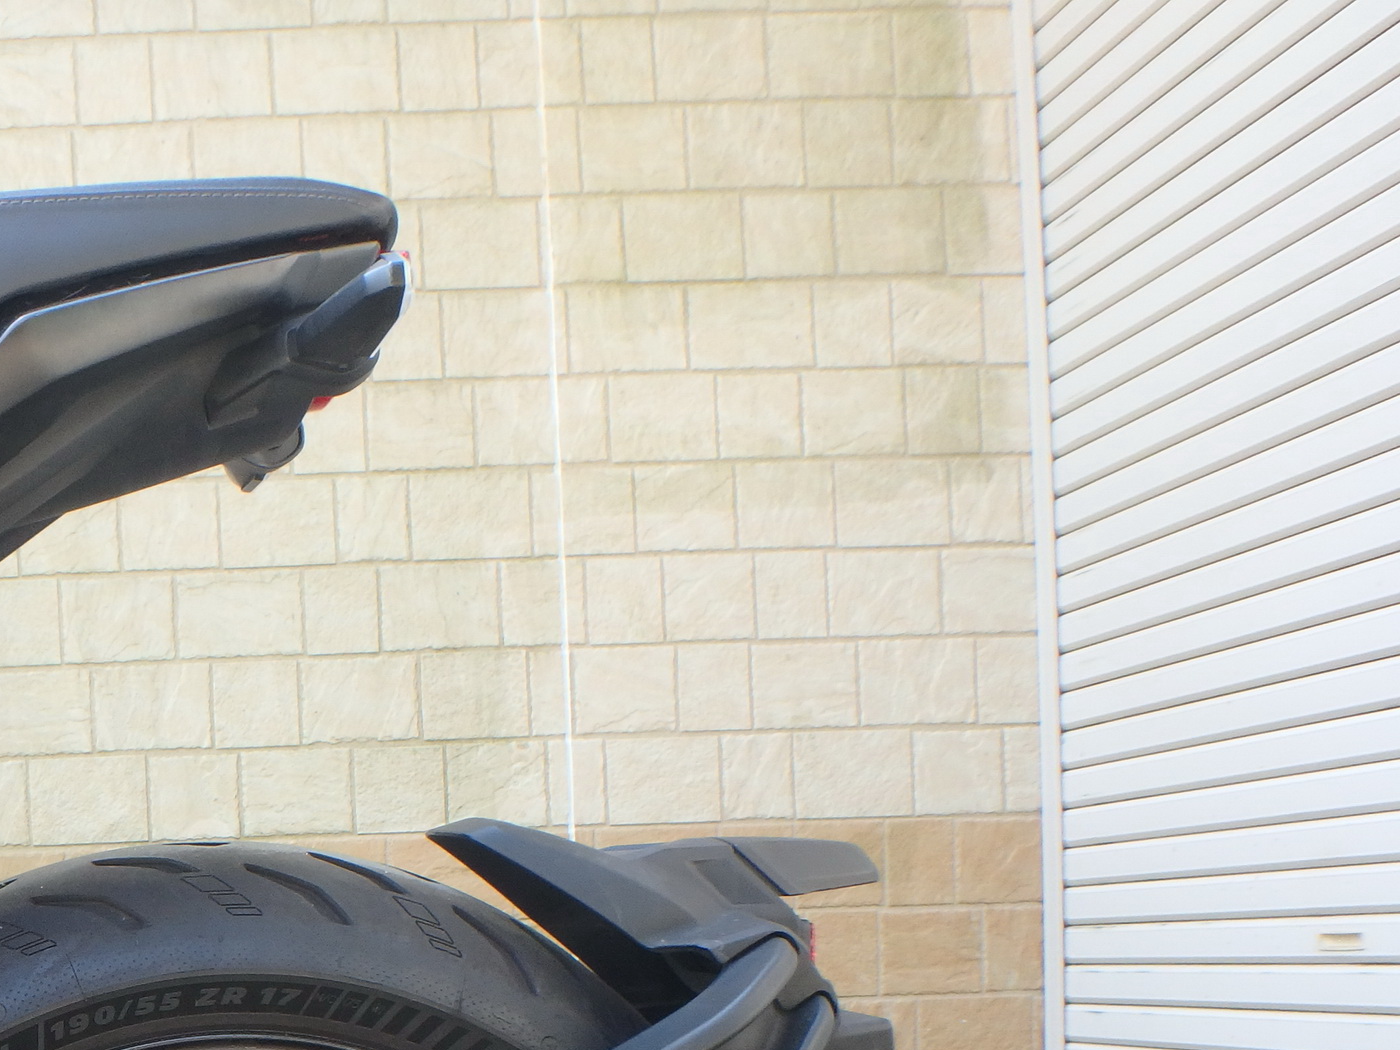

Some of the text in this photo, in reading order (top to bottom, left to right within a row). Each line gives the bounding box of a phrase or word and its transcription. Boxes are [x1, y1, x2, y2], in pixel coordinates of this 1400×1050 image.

[50, 991, 183, 1041] 190/55
[194, 986, 248, 1007] ZR
[260, 987, 303, 1007] 17
